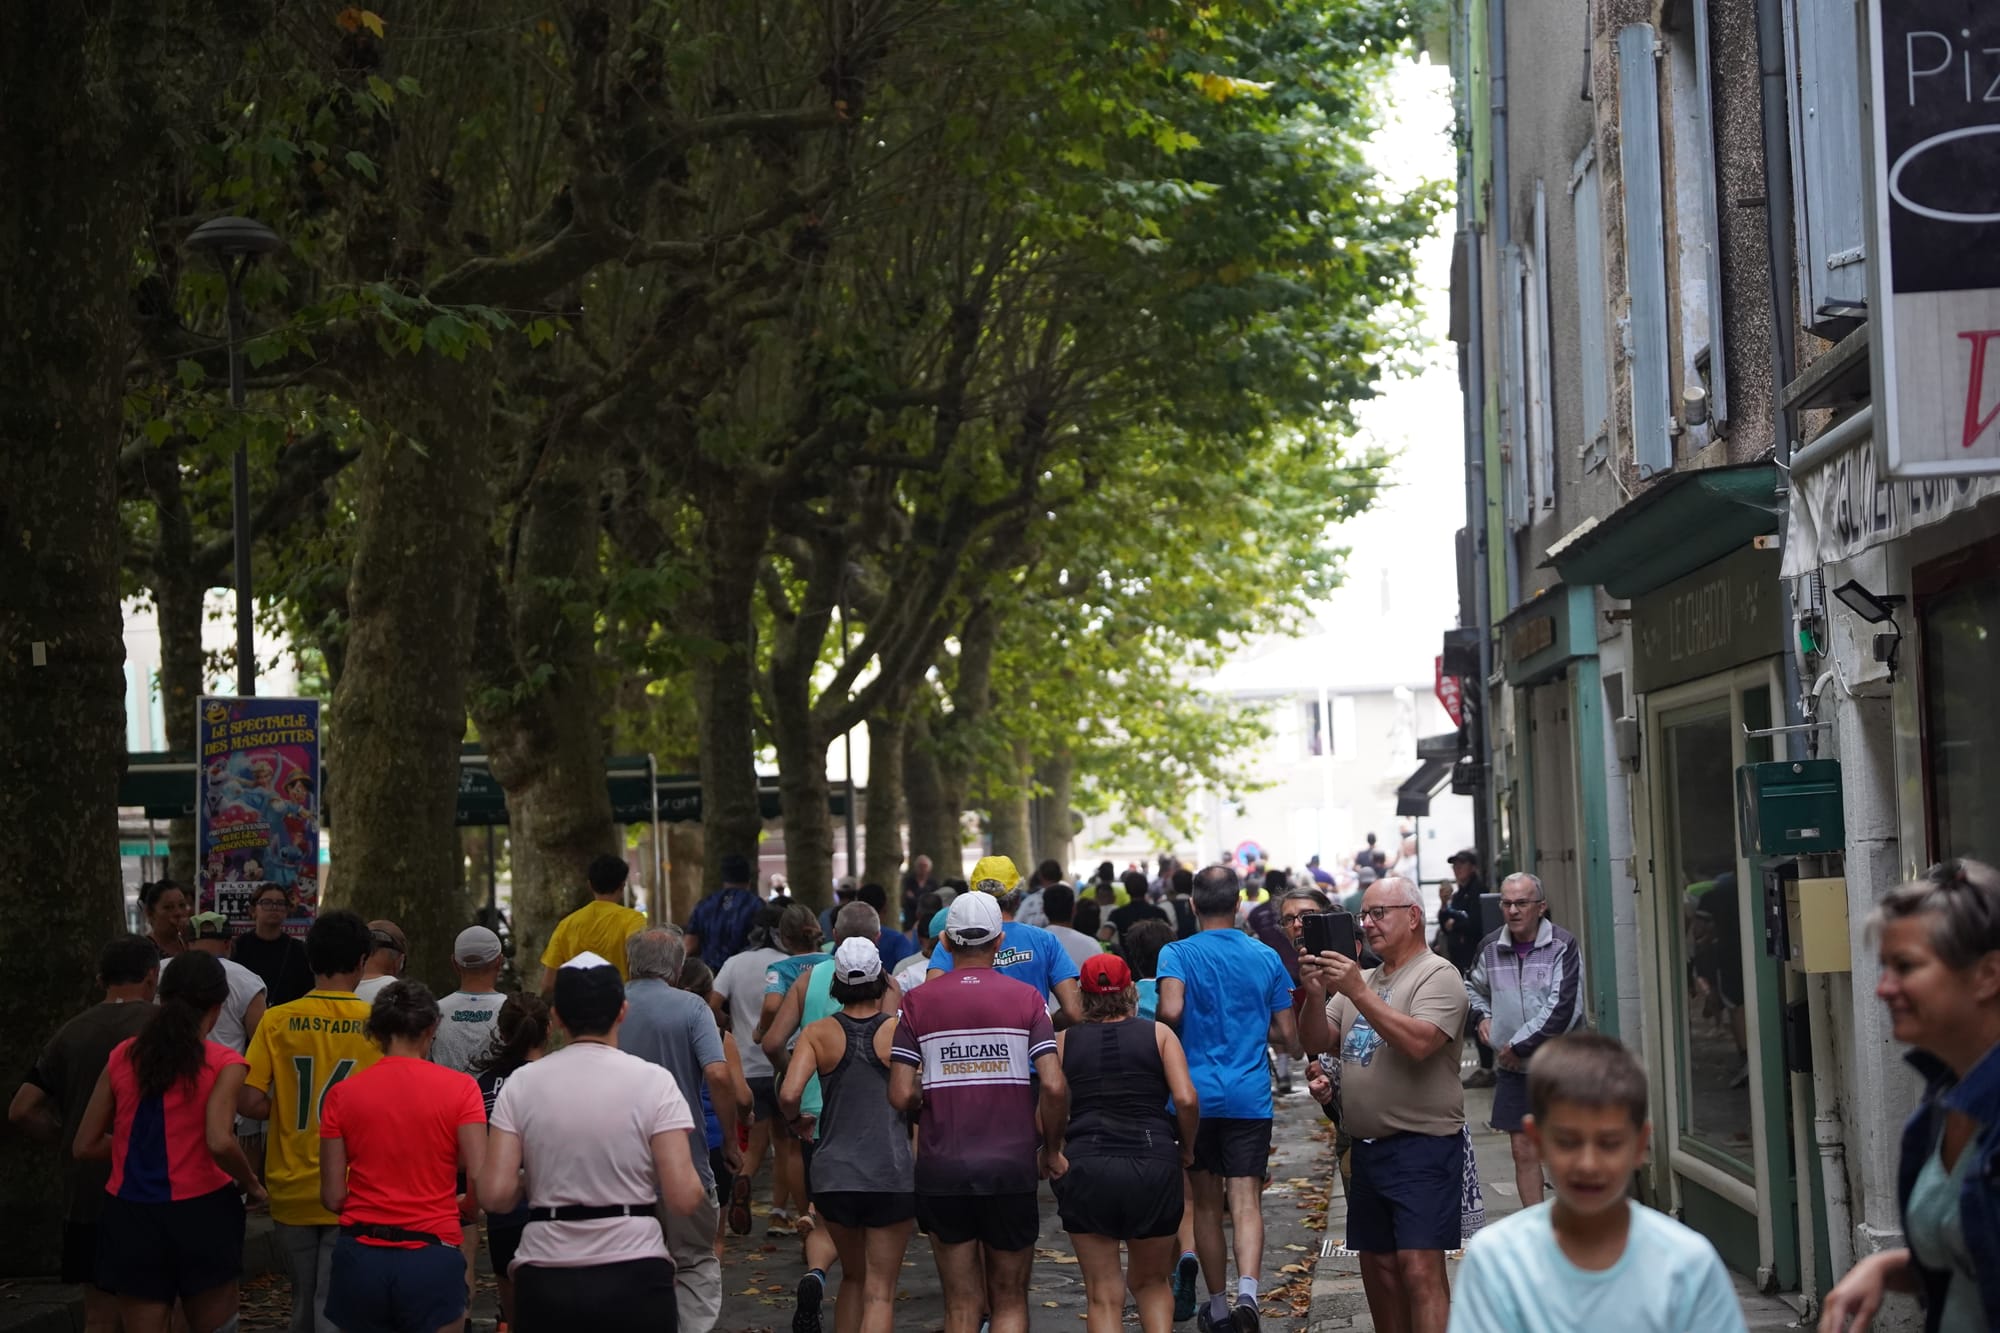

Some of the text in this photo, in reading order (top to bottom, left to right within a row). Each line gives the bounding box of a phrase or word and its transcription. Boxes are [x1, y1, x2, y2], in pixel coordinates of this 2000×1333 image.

[1669, 597, 1683, 662] LE
[212, 714, 308, 739] LE SPECTACLE
[204, 728, 315, 757] DES MASCOTTES
[999, 950, 1013, 960] LAC
[289, 1016, 362, 1034] MASTADR
[940, 1042, 1009, 1060] PÉLICANS
[942, 1060, 1010, 1076] ROSEMONT
